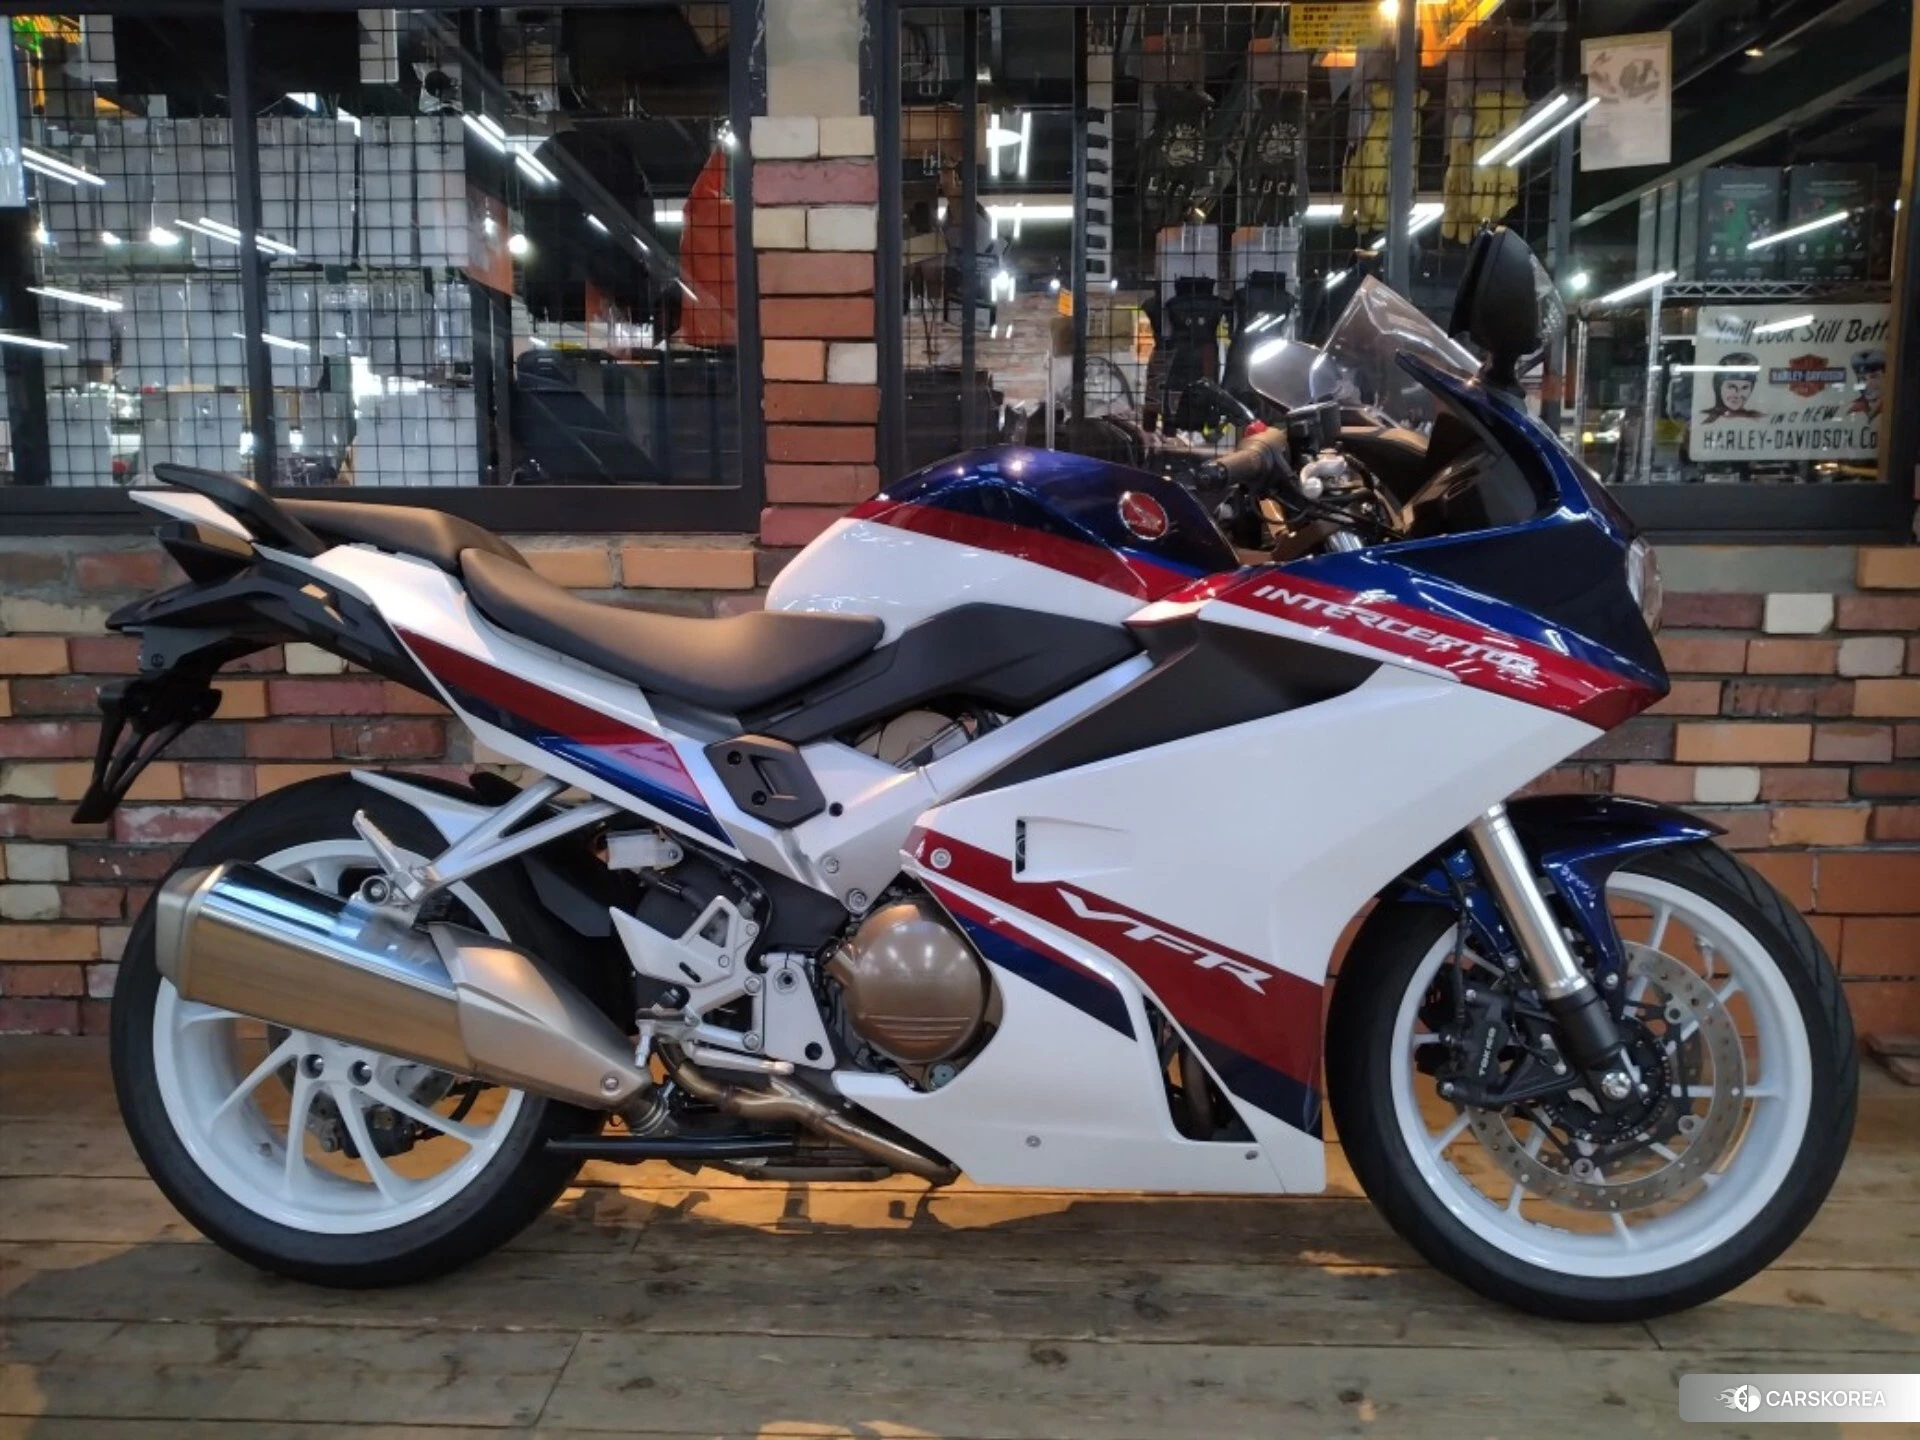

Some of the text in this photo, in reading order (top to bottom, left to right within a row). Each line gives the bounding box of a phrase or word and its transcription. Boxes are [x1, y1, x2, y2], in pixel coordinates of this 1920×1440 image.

[1248, 178, 1299, 196] LUCK
[1800, 319, 1842, 344] Still
[1844, 318, 1890, 344] Bett
[1802, 405, 1841, 422] NEW
[1704, 429, 1853, 450] HARLEY-DAVIDSON
[1252, 585, 1541, 677] INTERCEPTOR
[1056, 888, 1273, 995] VFR
